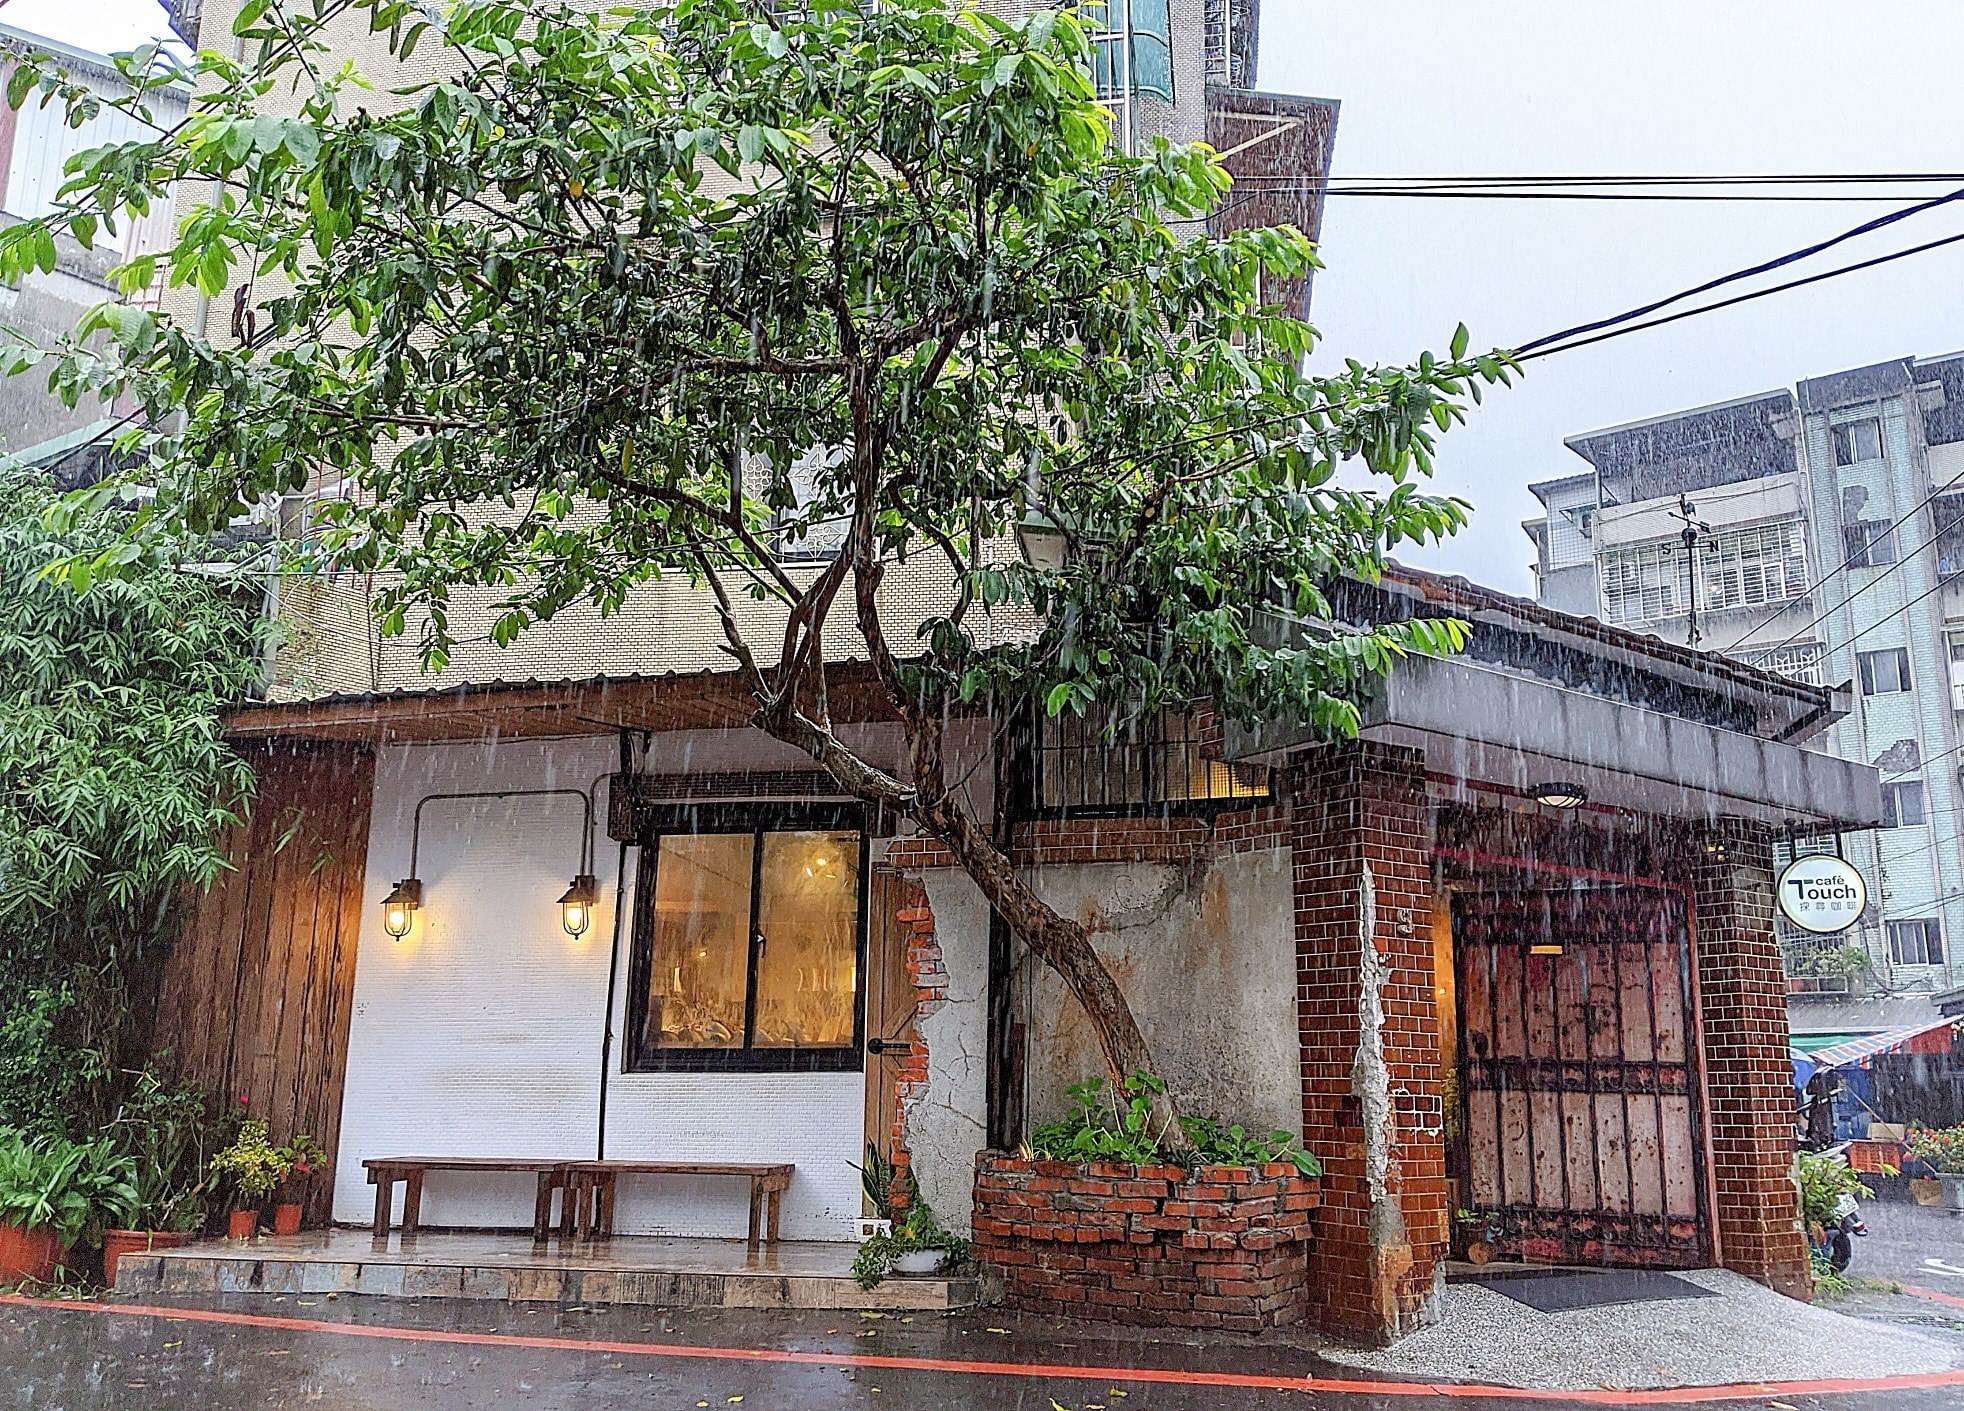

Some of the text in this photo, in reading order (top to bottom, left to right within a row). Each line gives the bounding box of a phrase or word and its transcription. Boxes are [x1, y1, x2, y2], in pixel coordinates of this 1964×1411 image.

[1662, 543, 1671, 555] S
[1709, 540, 1720, 552] N
[1787, 879, 1856, 899] Touch
